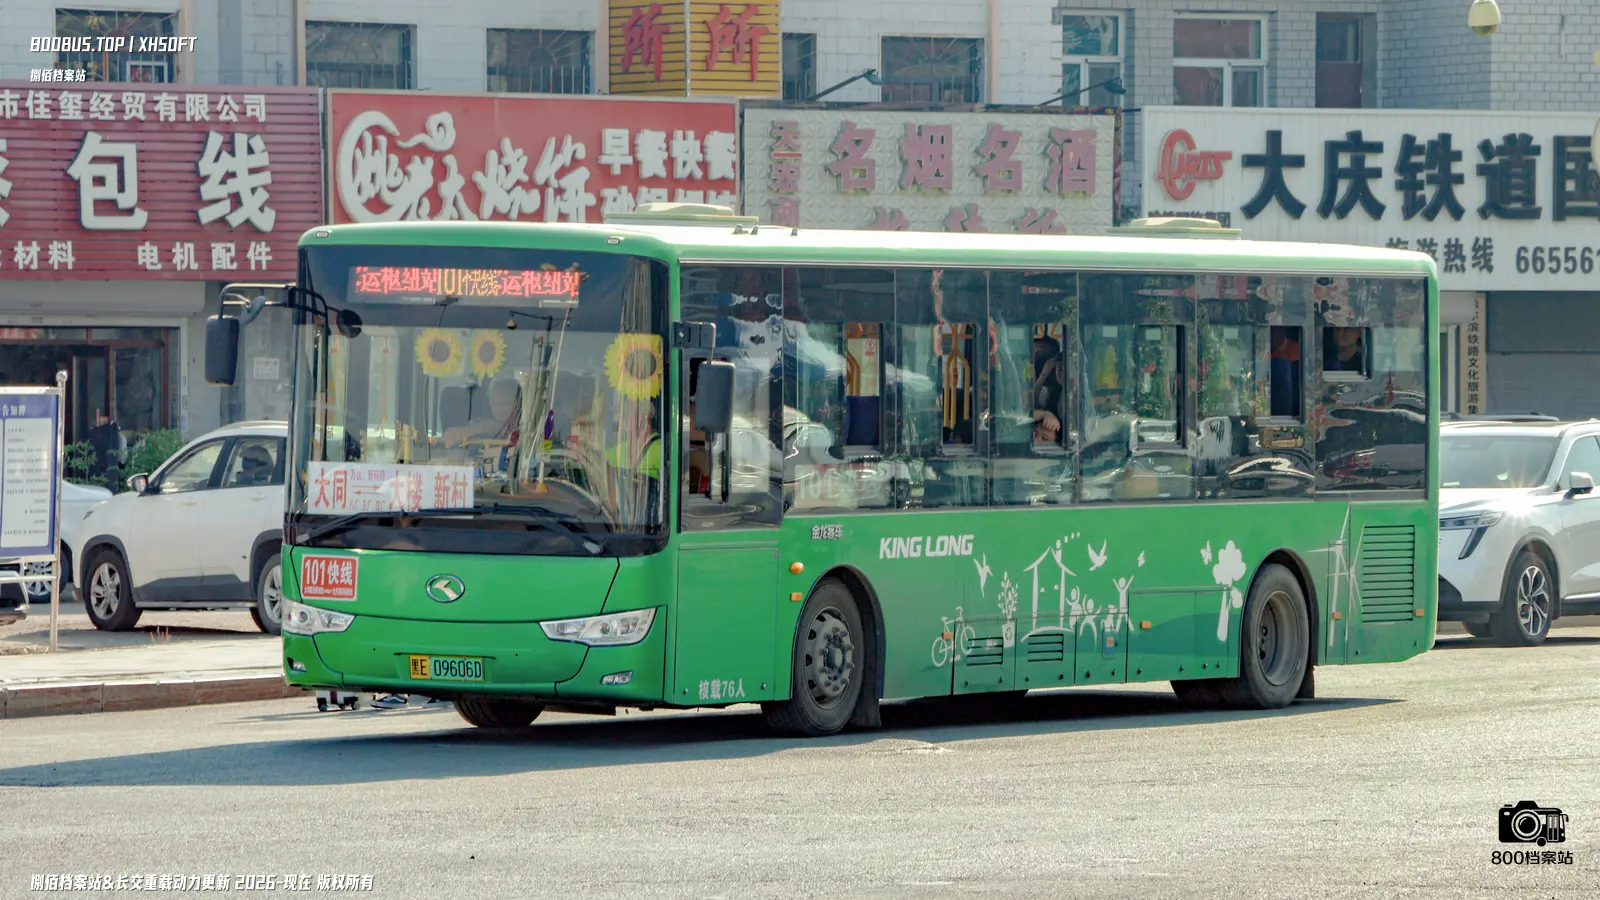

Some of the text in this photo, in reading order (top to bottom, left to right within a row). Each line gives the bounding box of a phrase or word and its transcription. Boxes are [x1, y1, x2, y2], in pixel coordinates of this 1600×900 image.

[621, 3, 670, 82] 所
[704, 4, 770, 82] 所
[0, 90, 267, 122] 市佳玺经贸有限公司
[598, 128, 736, 181] 早餐快餐
[824, 121, 1098, 196] 名烟名酒
[0, 131, 276, 232] 包线
[1240, 130, 1600, 222] 大庆铁道国
[14, 241, 273, 271] 材料 电机配件
[1467, 299, 1480, 414] 滨铁路文化旅游集
[314, 468, 348, 510] 大同
[433, 471, 468, 509] 新村
[811, 524, 843, 540] 金龙客车
[879, 534, 975, 559] KING LONG
[304, 559, 353, 585] 101快线
[433, 659, 482, 678] 09606D
[698, 678, 746, 700] 核载76人
